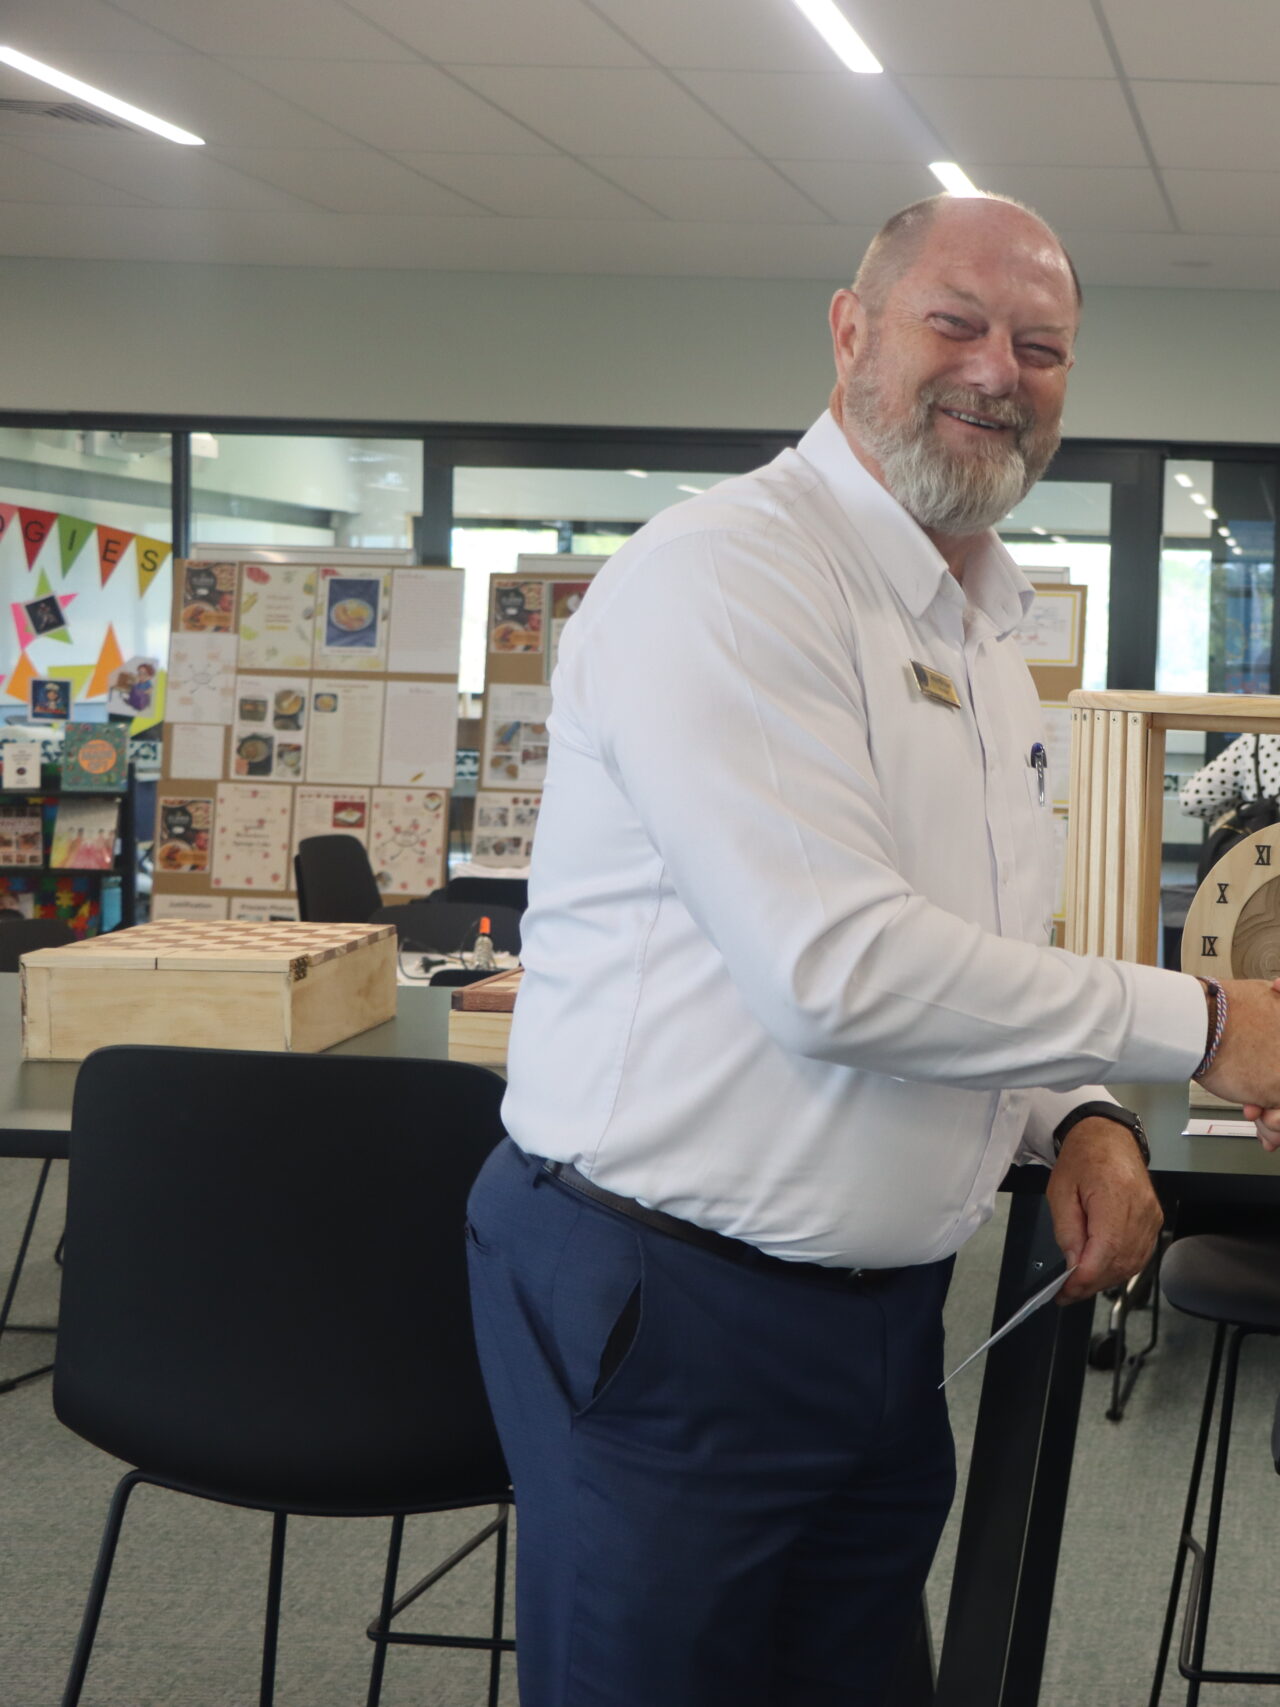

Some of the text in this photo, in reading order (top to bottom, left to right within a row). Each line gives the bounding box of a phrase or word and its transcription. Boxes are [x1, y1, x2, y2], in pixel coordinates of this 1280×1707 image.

[0, 514, 160, 572] GIES
[1254, 844, 1272, 866] XI
[1216, 883, 1229, 904] X
[1201, 936, 1218, 957] IX
